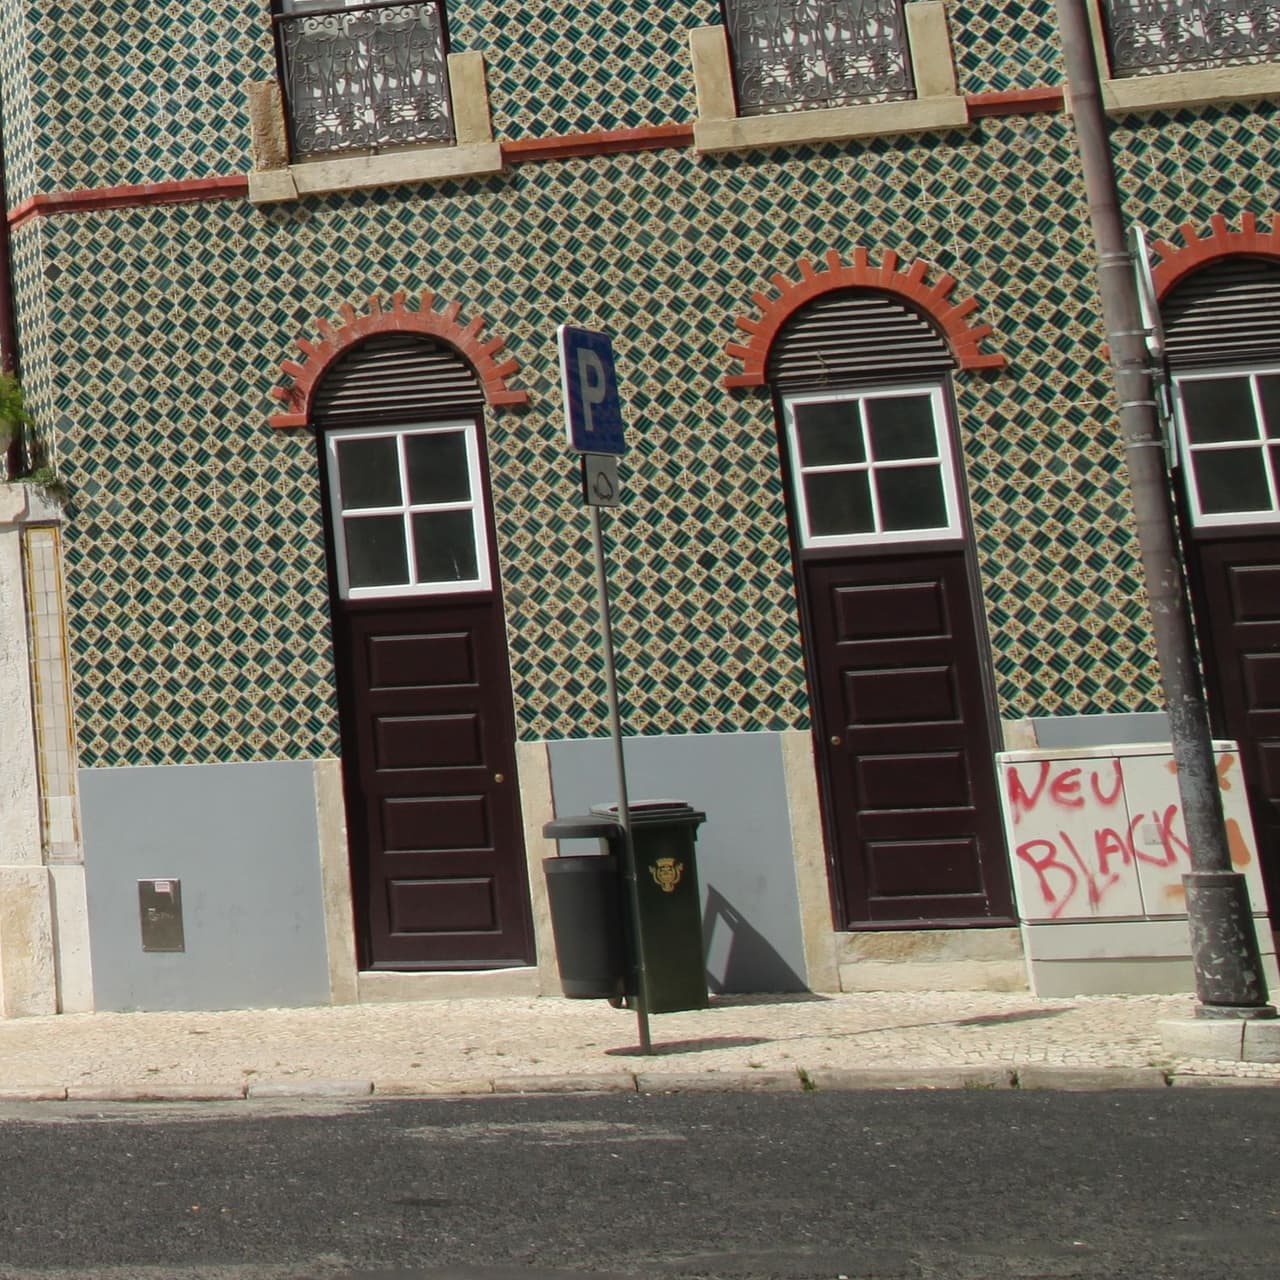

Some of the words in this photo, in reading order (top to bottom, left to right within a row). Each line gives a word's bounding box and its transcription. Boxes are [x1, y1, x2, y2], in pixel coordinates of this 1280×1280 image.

[576, 347, 607, 432] P
[1006, 757, 1123, 812] NEU
[1015, 804, 1191, 919] BLACK
